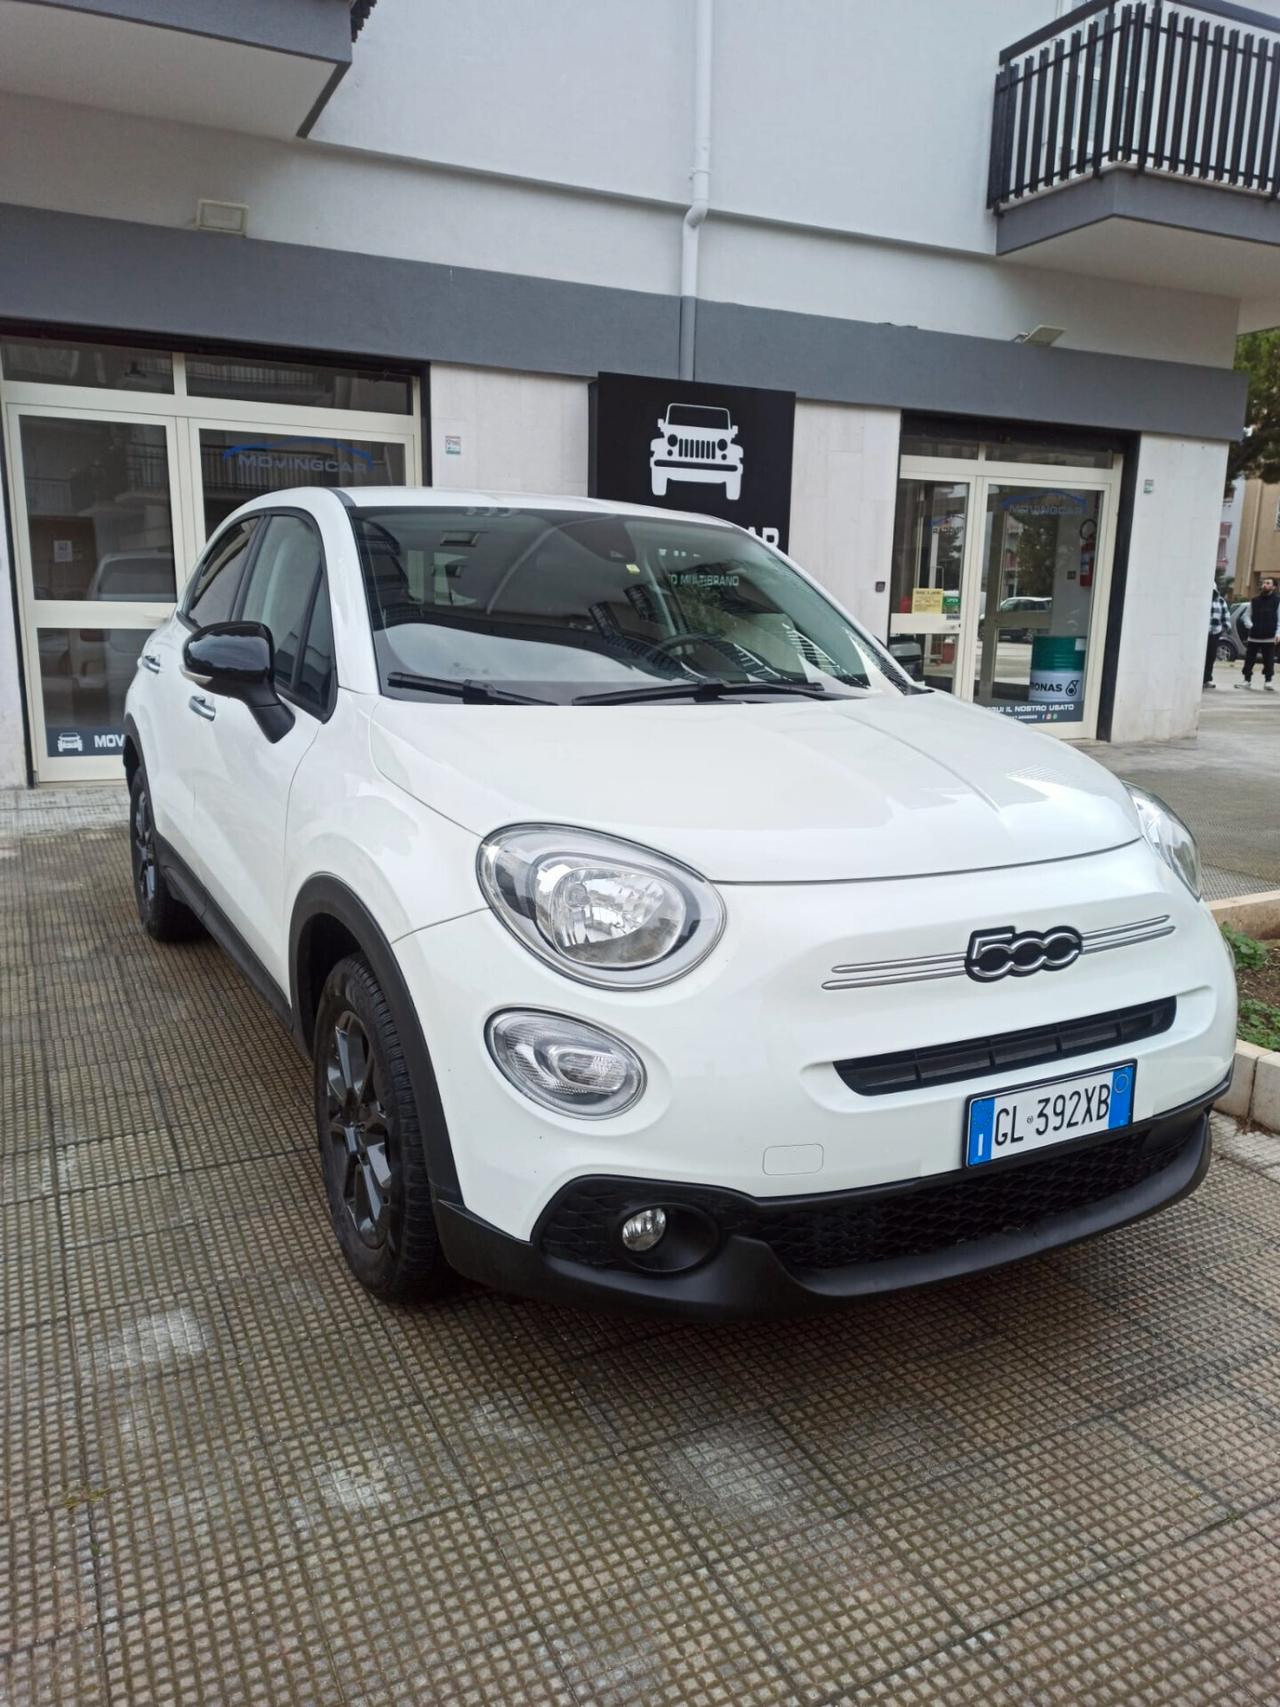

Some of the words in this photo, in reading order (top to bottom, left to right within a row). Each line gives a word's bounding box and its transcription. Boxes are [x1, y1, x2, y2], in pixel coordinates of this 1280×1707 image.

[238, 454, 368, 473] MOVINGCAR
[1014, 704, 1047, 713] NOSTRO
[1048, 703, 1075, 711] USATO
[966, 926, 1082, 982] 500
